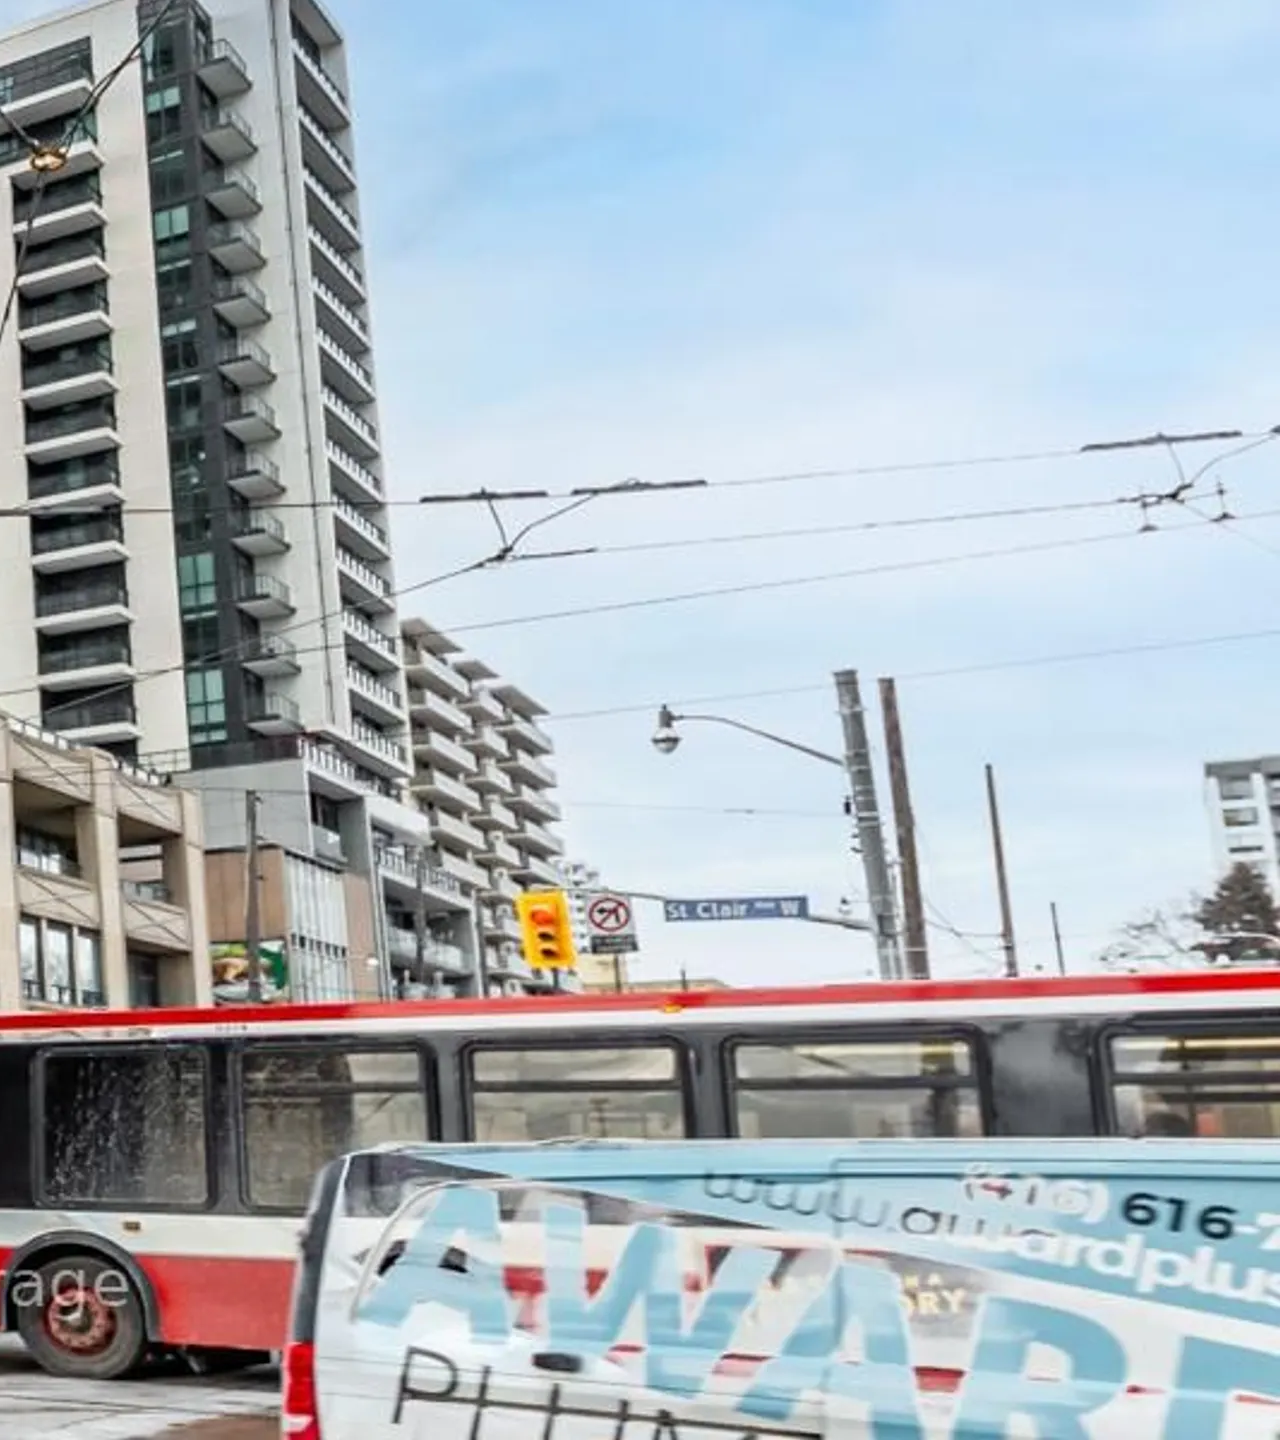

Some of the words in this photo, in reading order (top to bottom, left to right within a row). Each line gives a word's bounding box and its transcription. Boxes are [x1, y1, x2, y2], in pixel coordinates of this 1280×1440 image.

[666, 902, 689, 919] St
[696, 901, 749, 917] Clair
[780, 900, 801, 916] W
